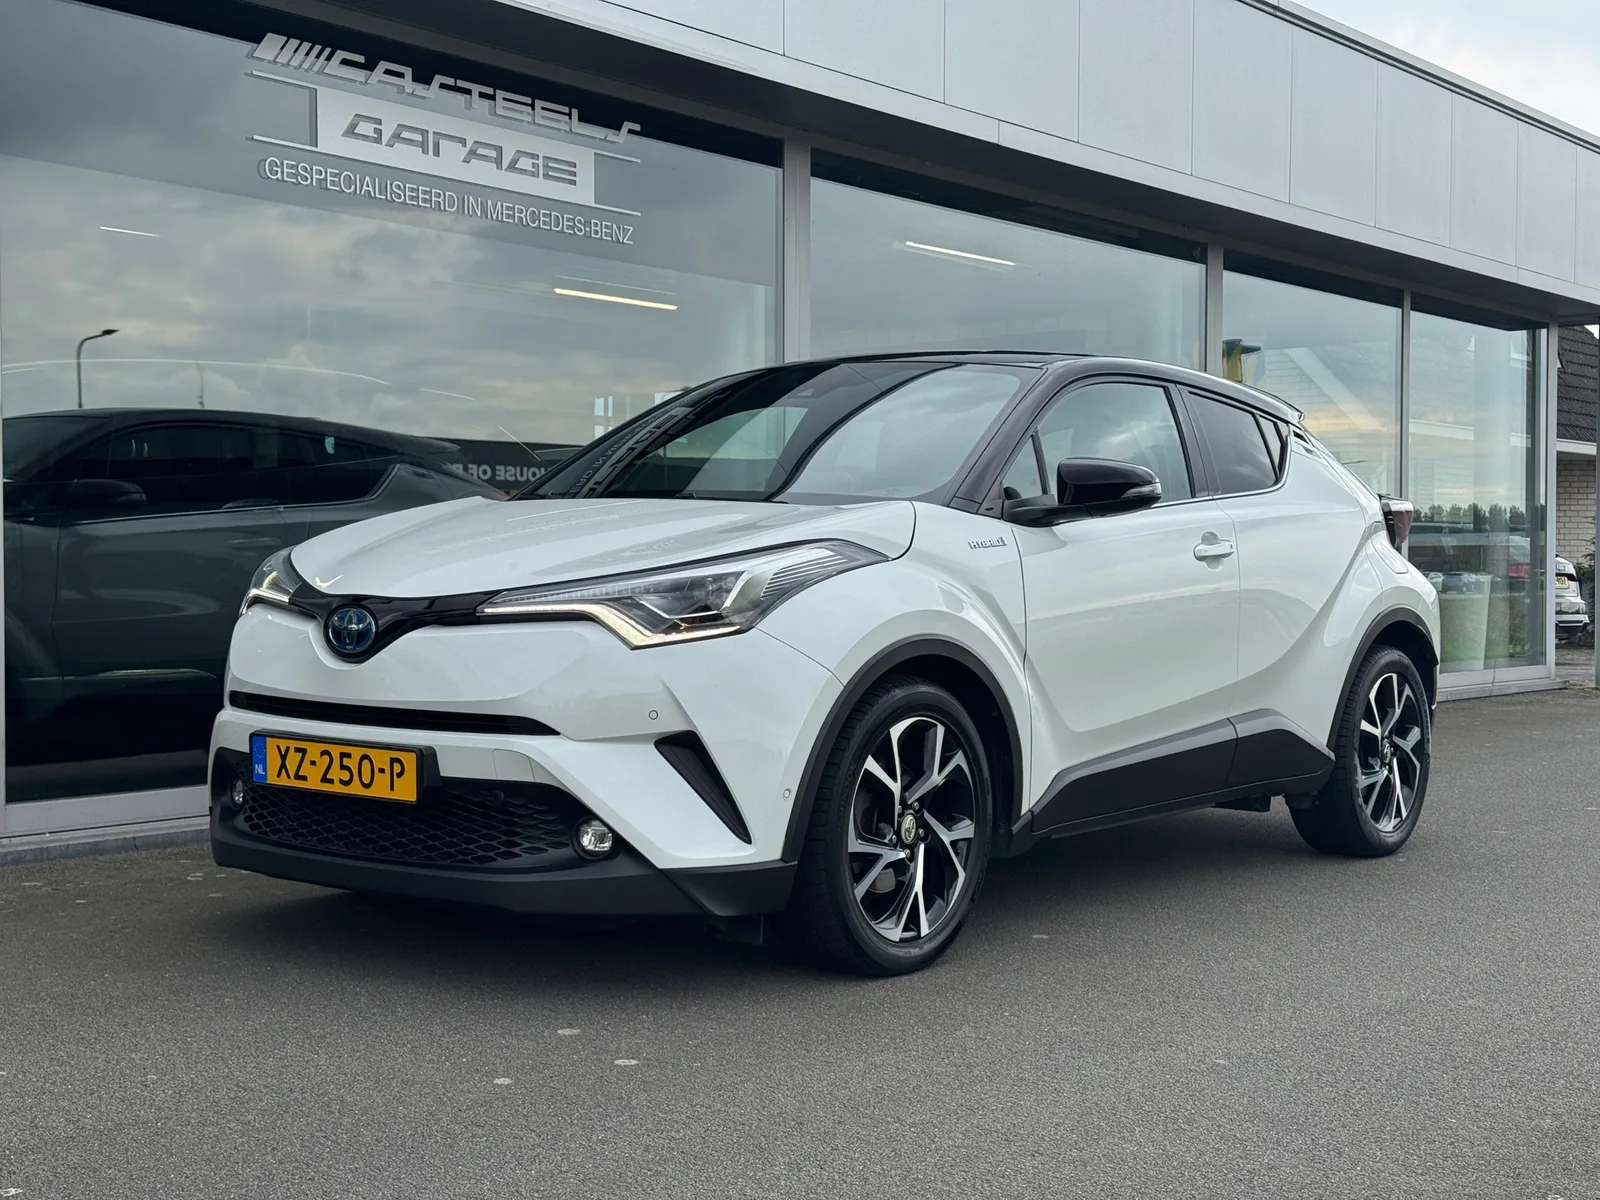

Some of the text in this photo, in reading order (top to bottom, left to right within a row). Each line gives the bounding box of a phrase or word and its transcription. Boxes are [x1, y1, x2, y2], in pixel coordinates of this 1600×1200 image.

[323, 49, 641, 144] CASTEELS
[341, 113, 578, 187] GARAGE
[264, 156, 634, 245] GESPECIALISEERD IN MERCEDES-BENZ
[254, 763, 266, 776] NL
[275, 744, 406, 792] XZ-250-P
